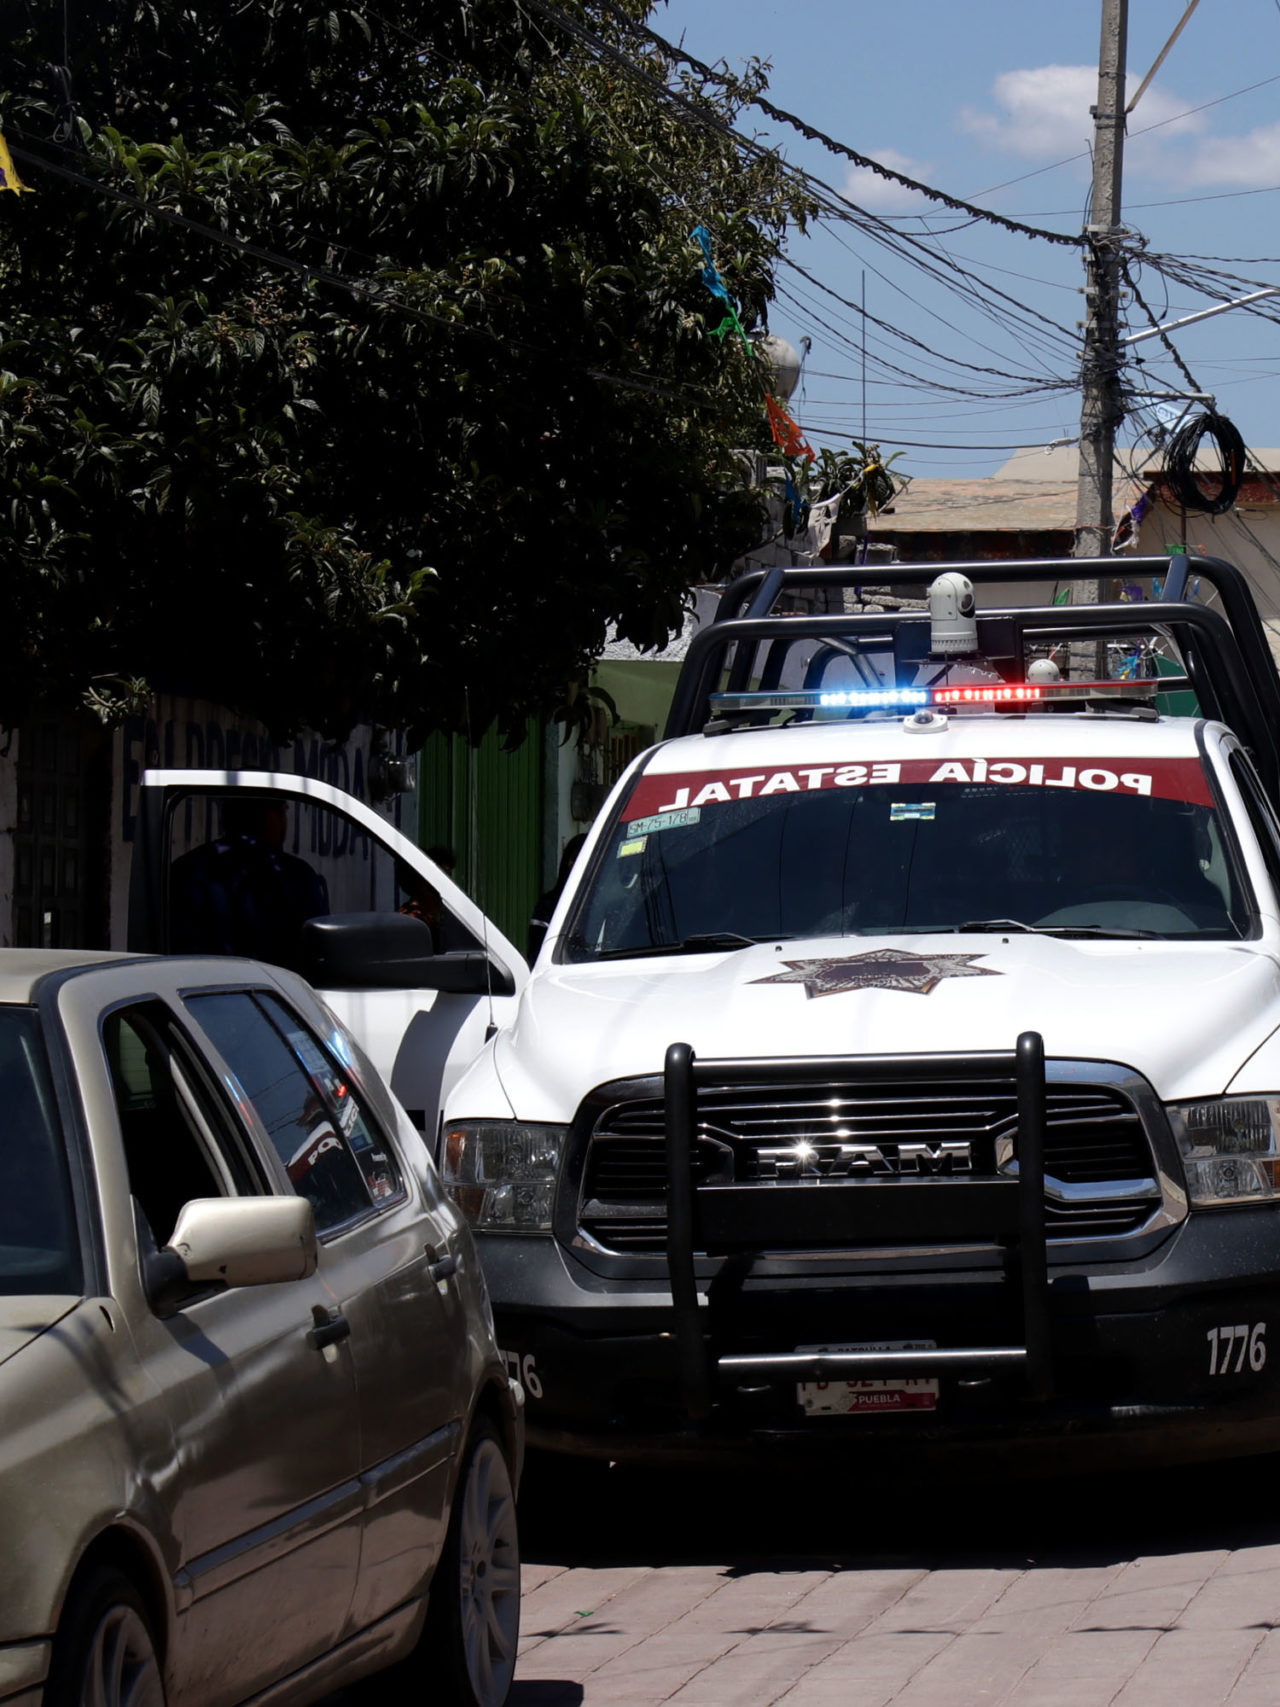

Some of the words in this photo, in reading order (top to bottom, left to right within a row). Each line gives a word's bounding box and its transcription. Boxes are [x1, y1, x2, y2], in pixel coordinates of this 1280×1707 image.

[756, 1142, 972, 1177] RAM
[1207, 1322, 1266, 1375] 1776
[858, 1394, 901, 1404] PUEBLA
